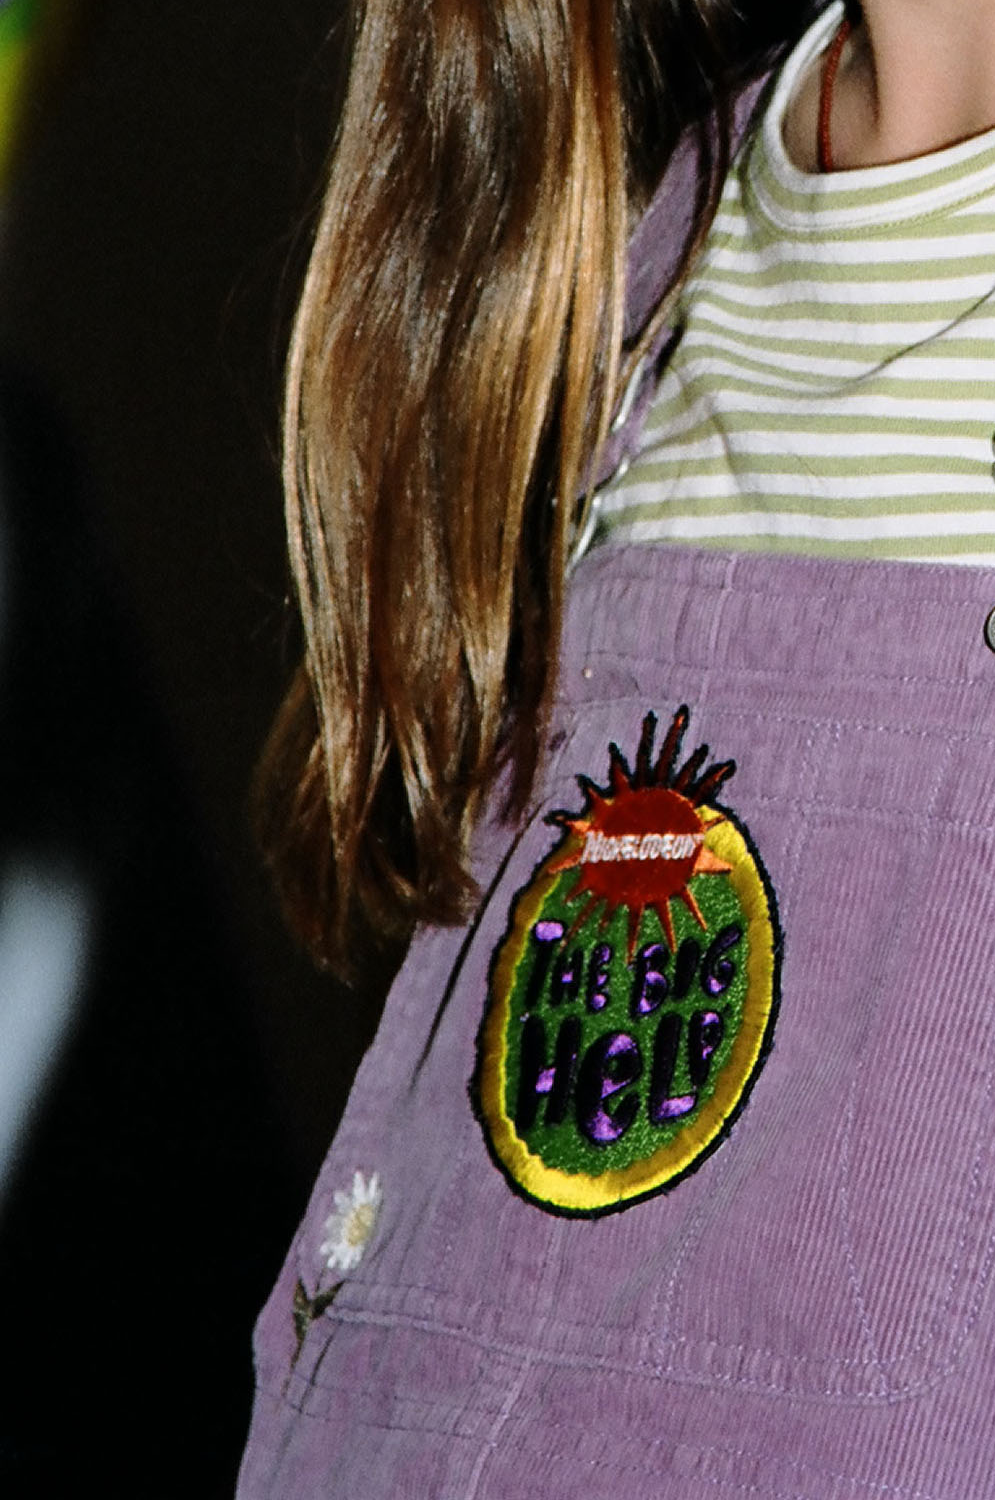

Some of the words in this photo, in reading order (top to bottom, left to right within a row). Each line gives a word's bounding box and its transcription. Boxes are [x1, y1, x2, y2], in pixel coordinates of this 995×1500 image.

[580, 831, 698, 864] NICKELODEON
[525, 920, 614, 1015] THE
[630, 924, 742, 1020] BIG
